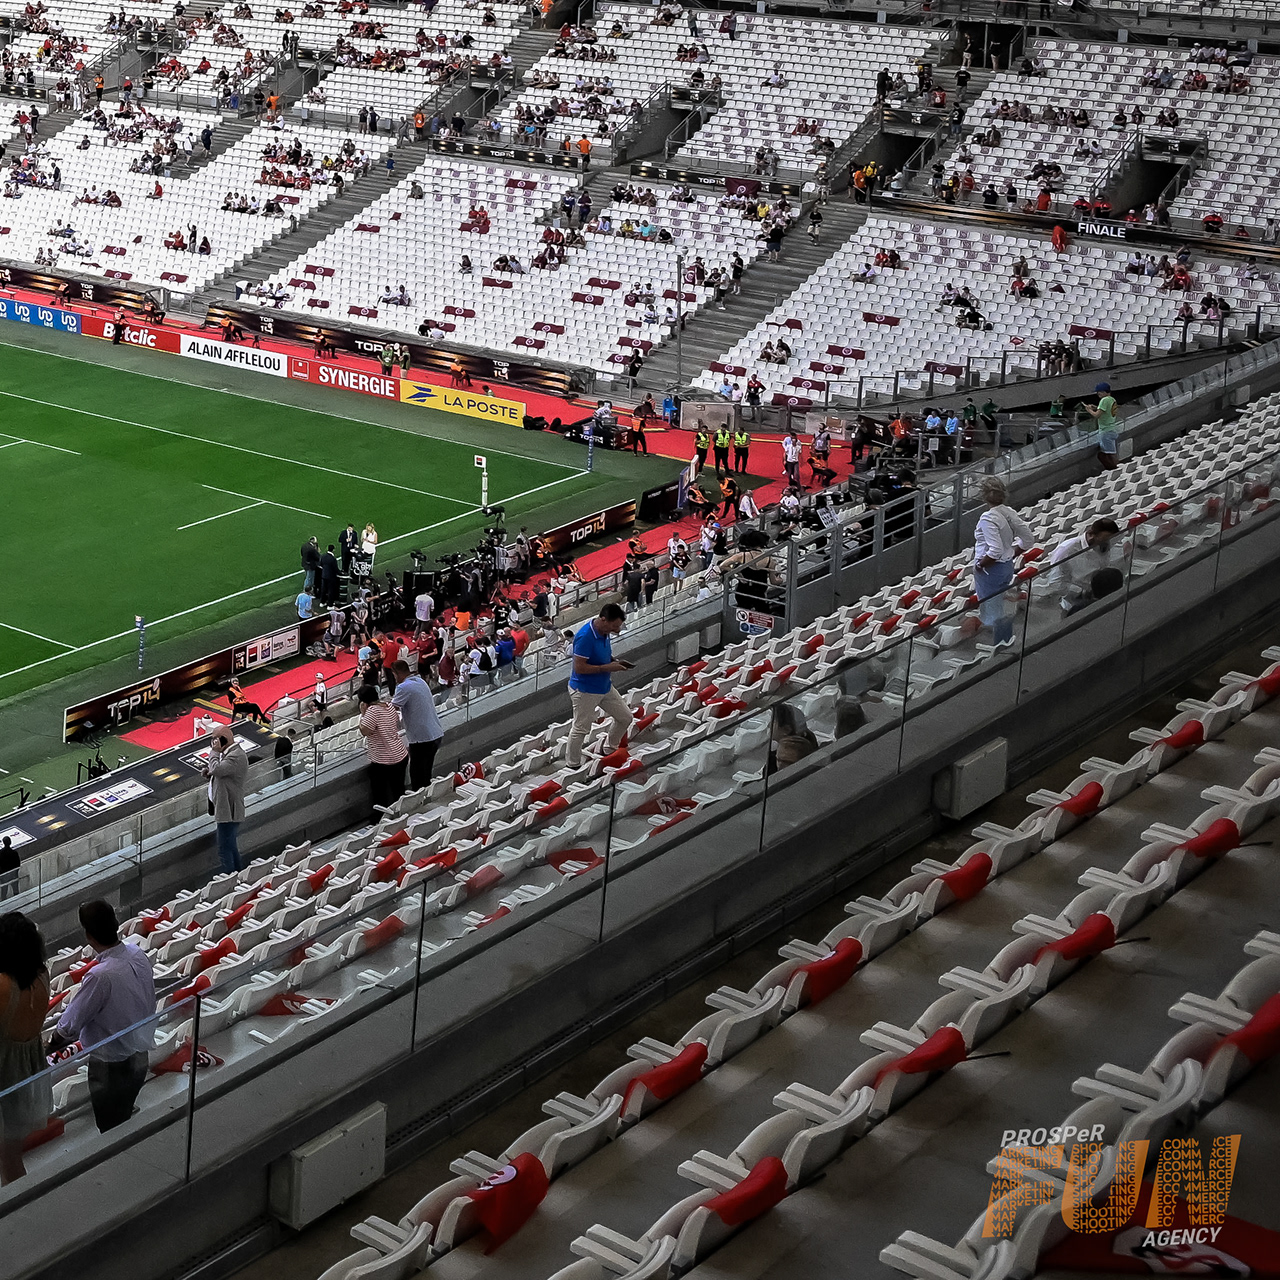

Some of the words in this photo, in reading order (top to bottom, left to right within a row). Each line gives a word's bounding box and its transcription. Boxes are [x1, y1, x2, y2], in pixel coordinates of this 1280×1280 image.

[187, 341, 222, 359] ALAIN
[225, 349, 281, 371] AFFLELOU
[319, 366, 395, 397] SYNERGIE
[444, 394, 464, 408] LA
[467, 399, 518, 419] POSTE
[571, 521, 606, 542] TOP14
[107, 687, 161, 718] TOP14
